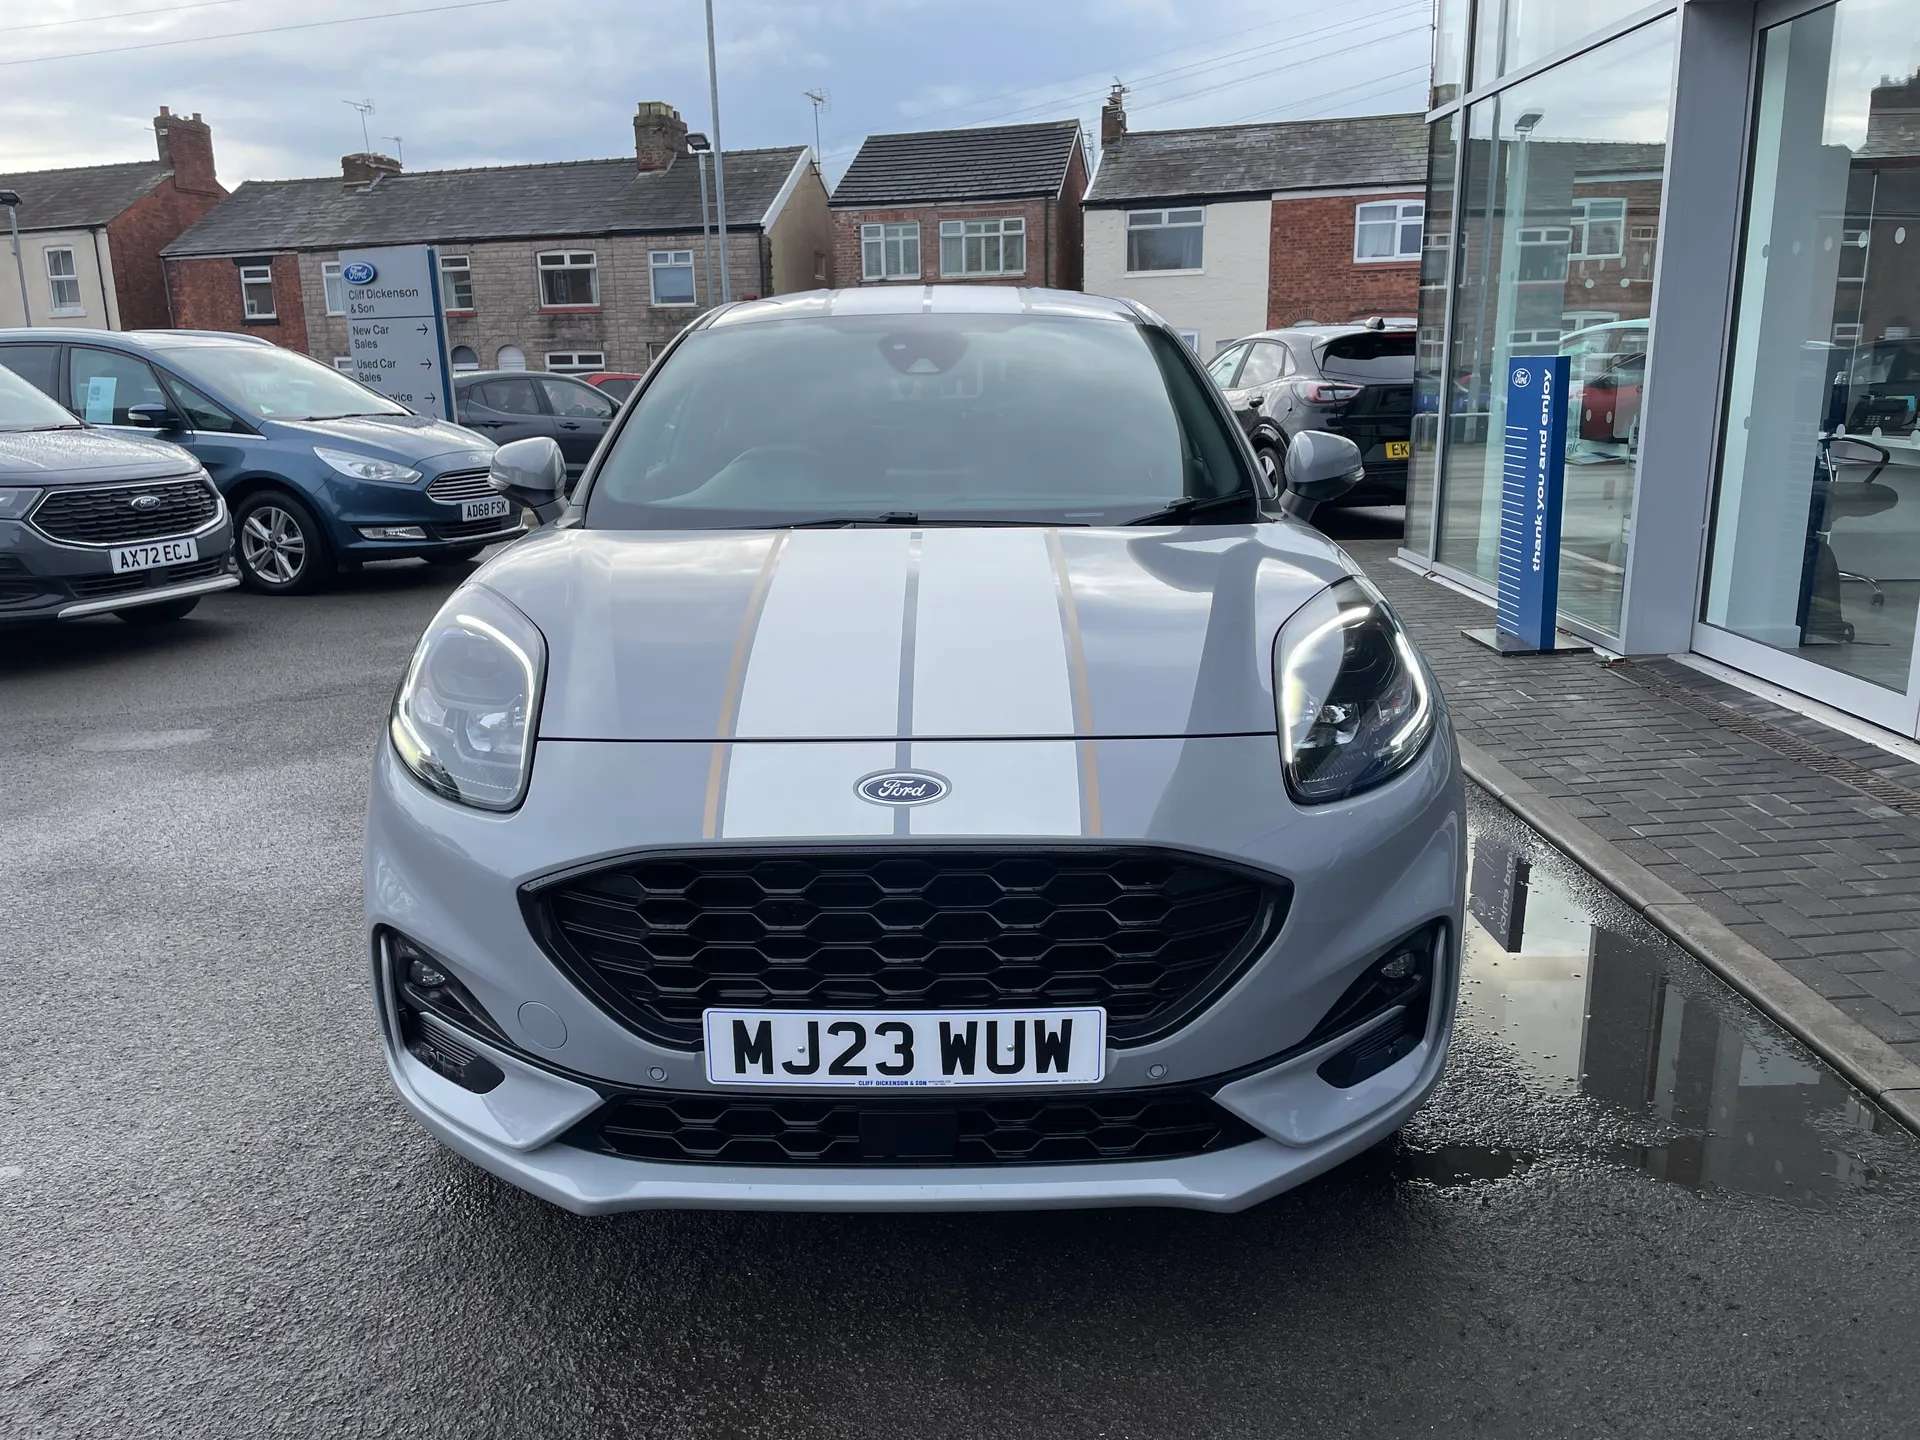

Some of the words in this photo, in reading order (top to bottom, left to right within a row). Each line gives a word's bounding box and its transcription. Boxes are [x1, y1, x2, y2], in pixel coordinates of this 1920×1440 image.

[348, 265, 367, 280] Ford
[348, 289, 365, 300] Cliff
[366, 288, 419, 300] Dickenson
[350, 303, 356, 313] &
[357, 303, 375, 313] Son
[352, 325, 371, 335] New
[372, 325, 389, 335] Car
[354, 339, 378, 349] Sales
[356, 359, 378, 369] Used
[379, 359, 396, 369] Car
[358, 372, 382, 382] Sales
[1541, 368, 1552, 426] enjoy
[1539, 430, 1547, 470] and
[1537, 473, 1545, 511] you
[467, 503, 490, 519] AD68
[491, 500, 507, 515] FSK
[1533, 514, 1543, 572] thank
[120, 546, 161, 569] AX72
[162, 541, 192, 561] ECJ
[878, 779, 927, 797] Ford
[732, 1019, 915, 1076] MJ23
[938, 1018, 1073, 1075] WUW
